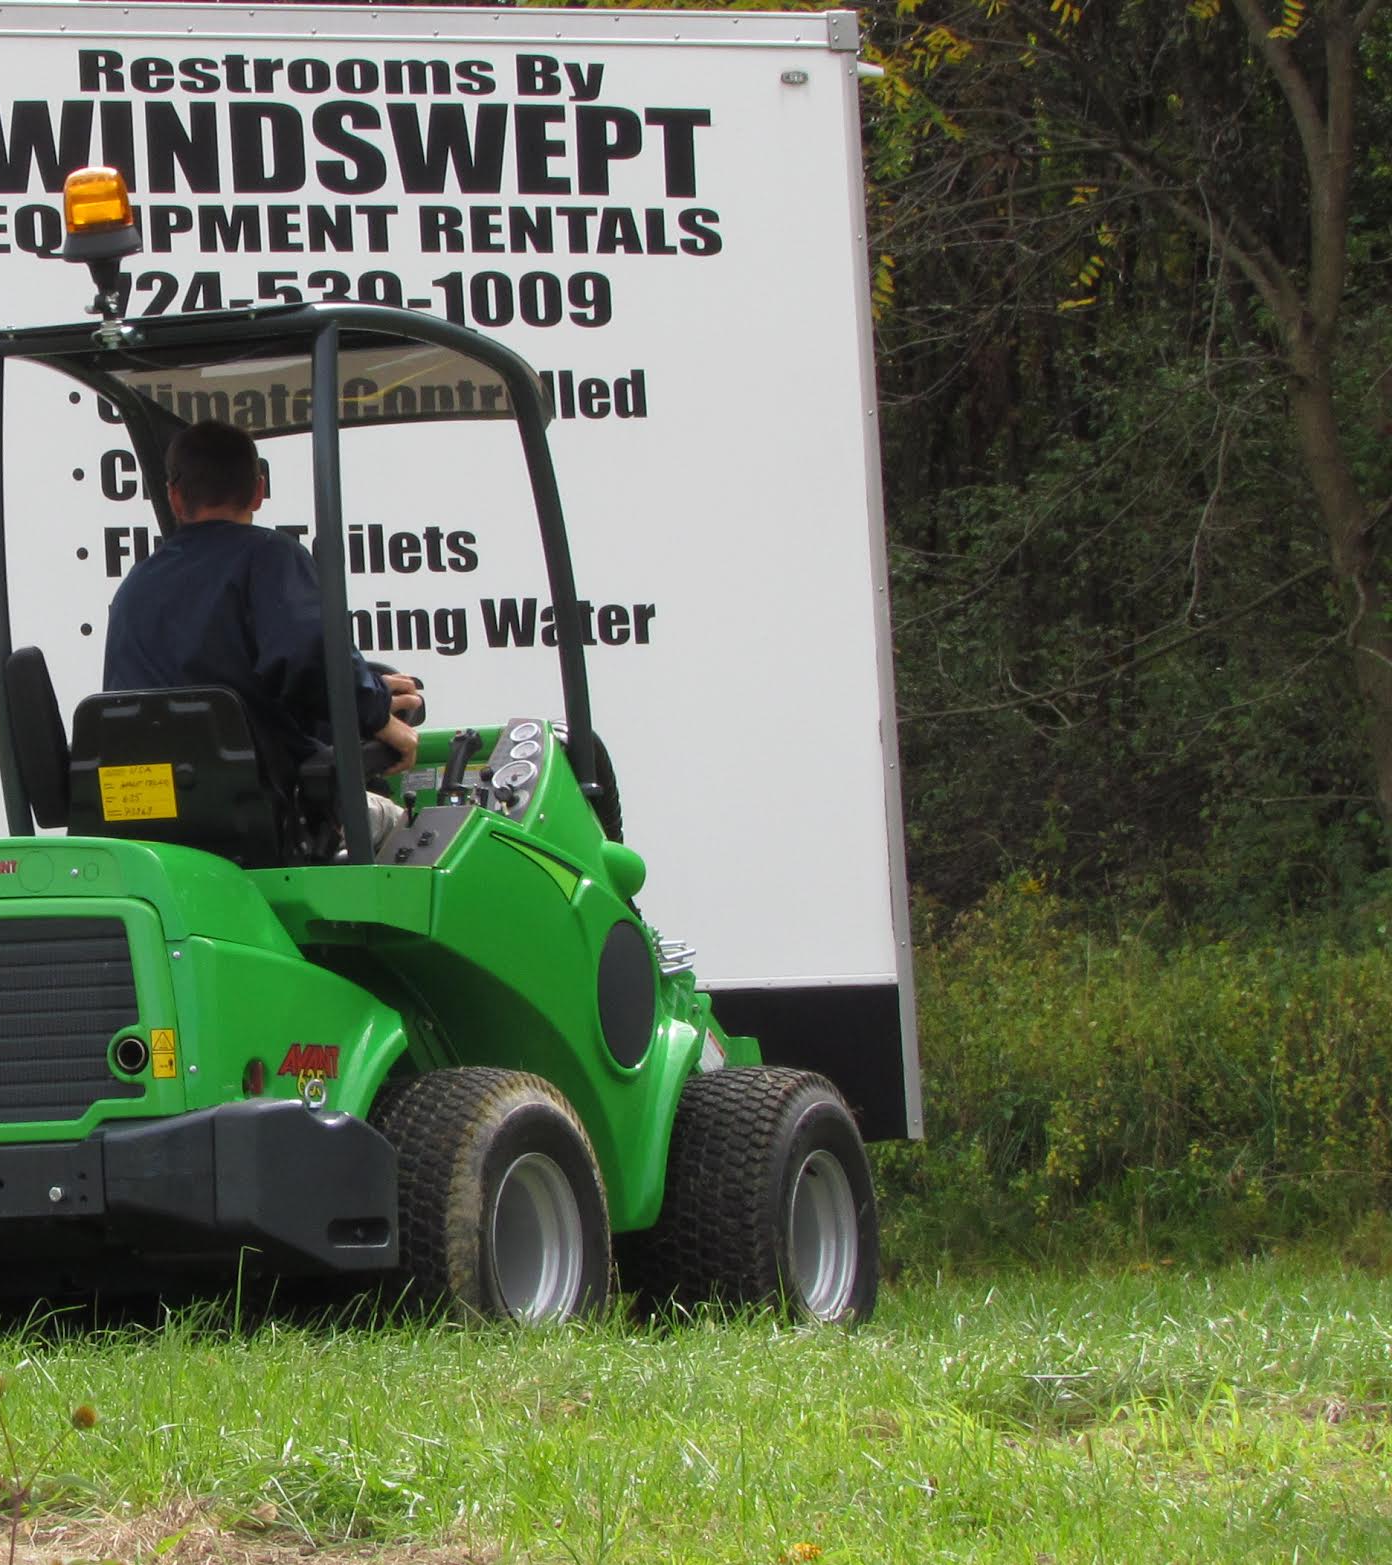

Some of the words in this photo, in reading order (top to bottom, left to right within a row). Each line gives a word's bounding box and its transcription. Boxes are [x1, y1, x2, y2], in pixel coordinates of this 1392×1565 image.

[79, 50, 495, 96] Restrooms
[516, 55, 604, 102] By
[420, 206, 723, 256] RENTALS
[342, 369, 647, 419] Contrlled
[275, 525, 480, 574] Tilets
